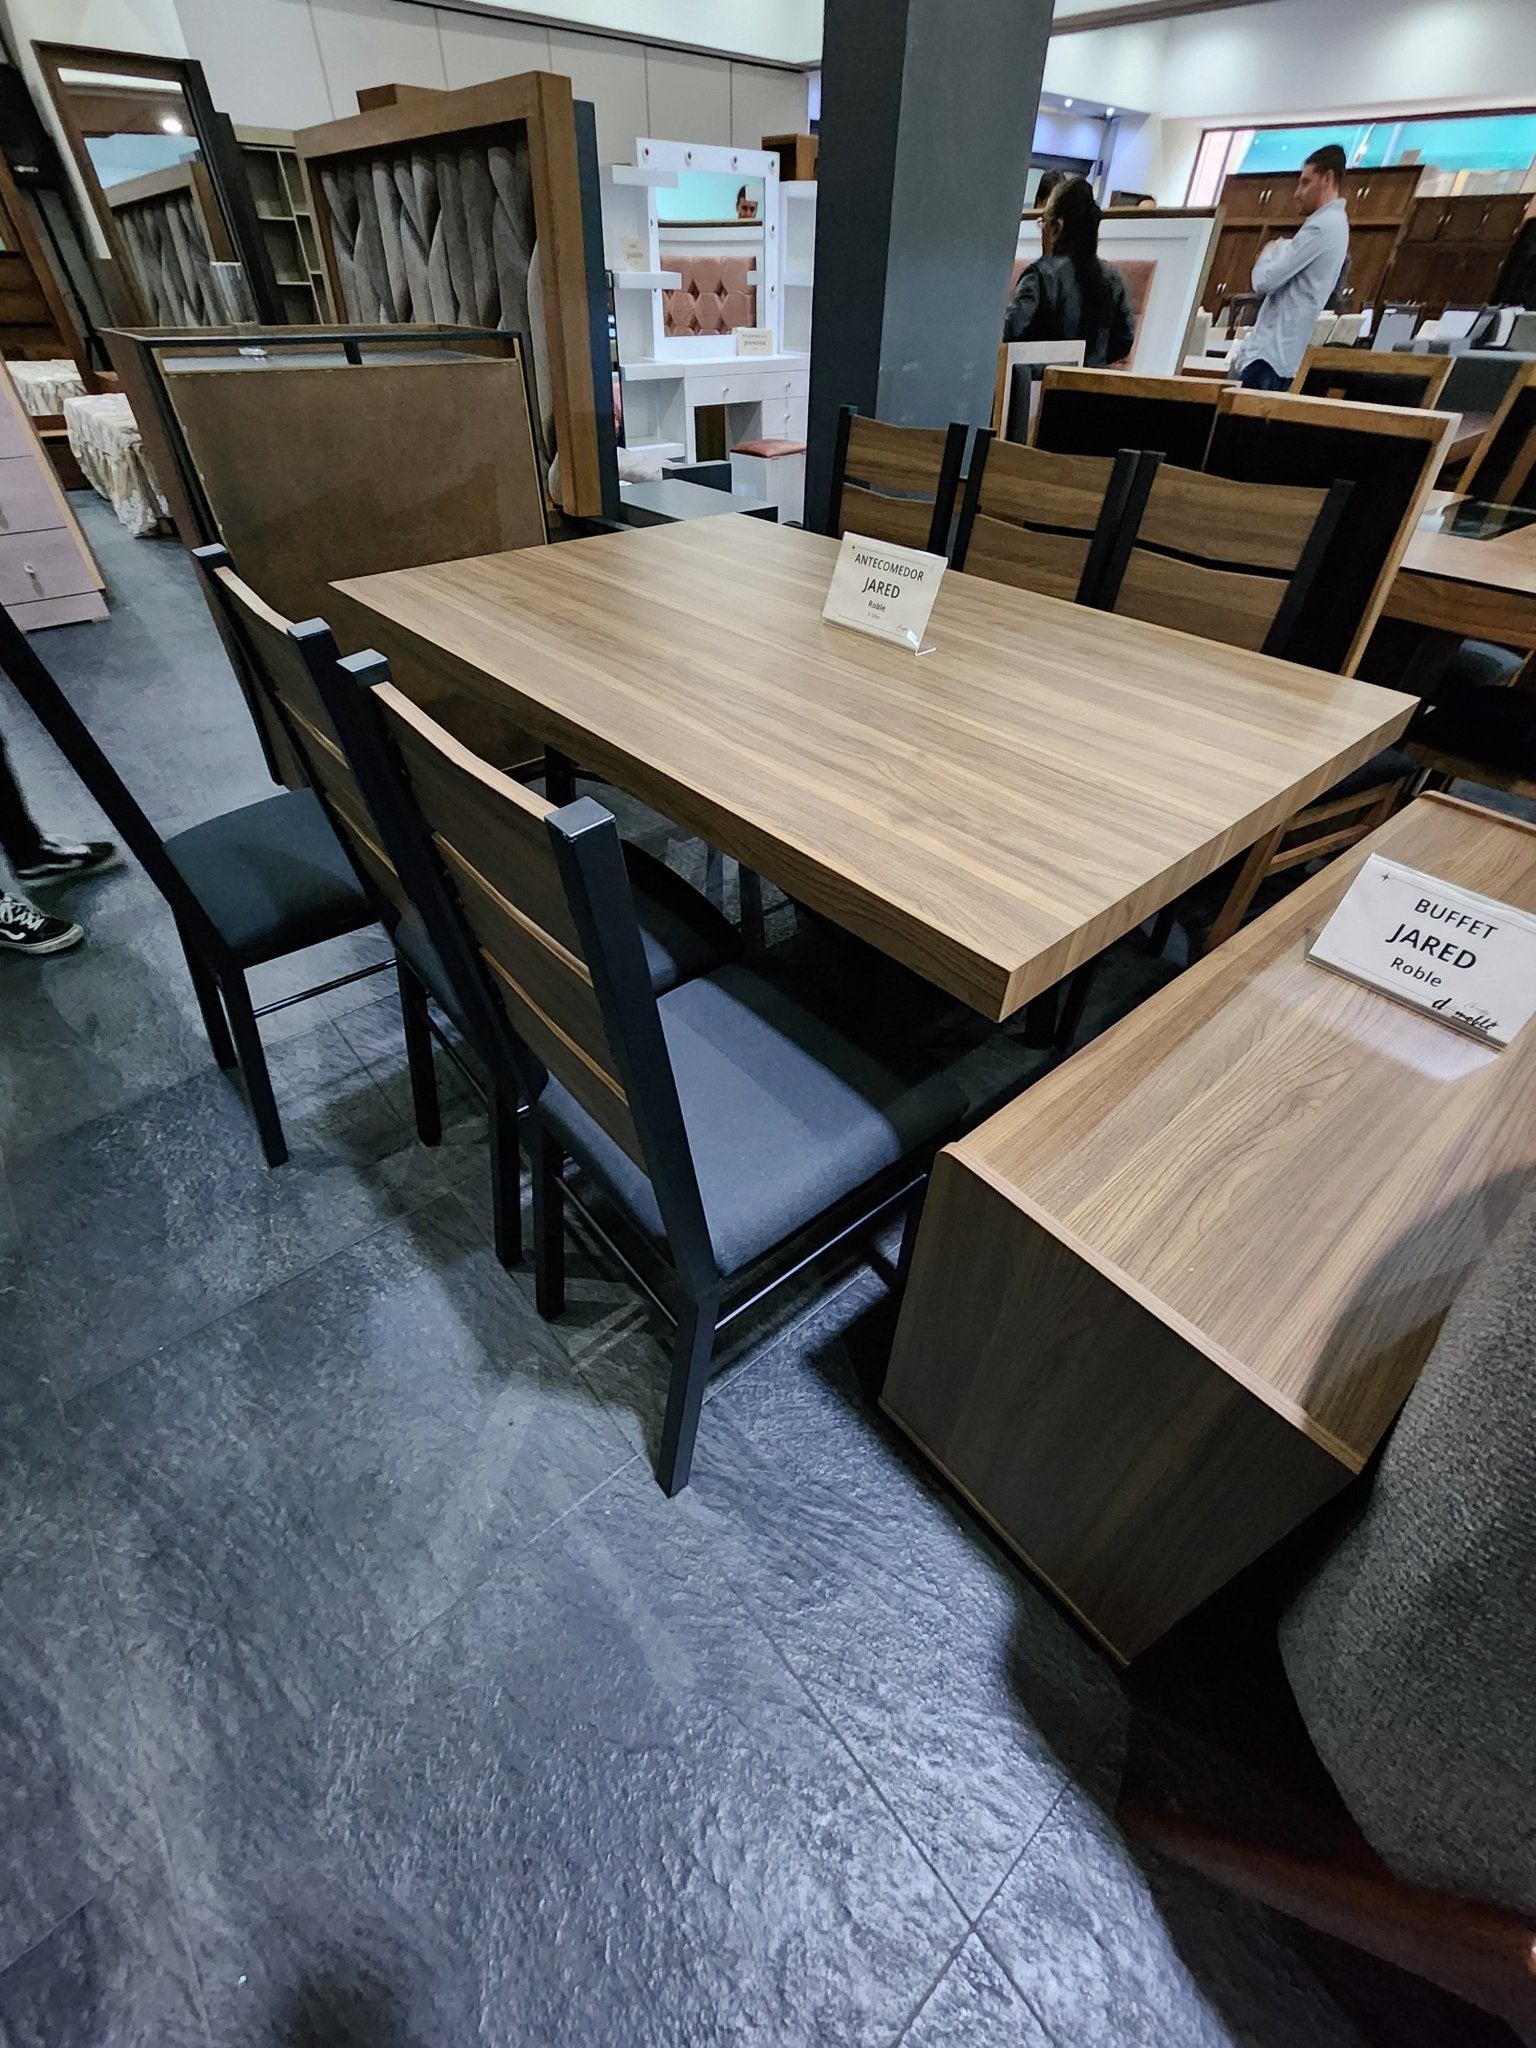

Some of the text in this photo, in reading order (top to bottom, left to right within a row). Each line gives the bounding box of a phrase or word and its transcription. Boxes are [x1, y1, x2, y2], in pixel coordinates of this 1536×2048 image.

[854, 552, 925, 582] ANTECOMEDOR
[861, 576, 901, 599] JARED
[867, 600, 886, 612] Roble
[1414, 898, 1499, 940] BUFFET
[1385, 923, 1478, 970] JARED
[1390, 956, 1442, 988] Roble
